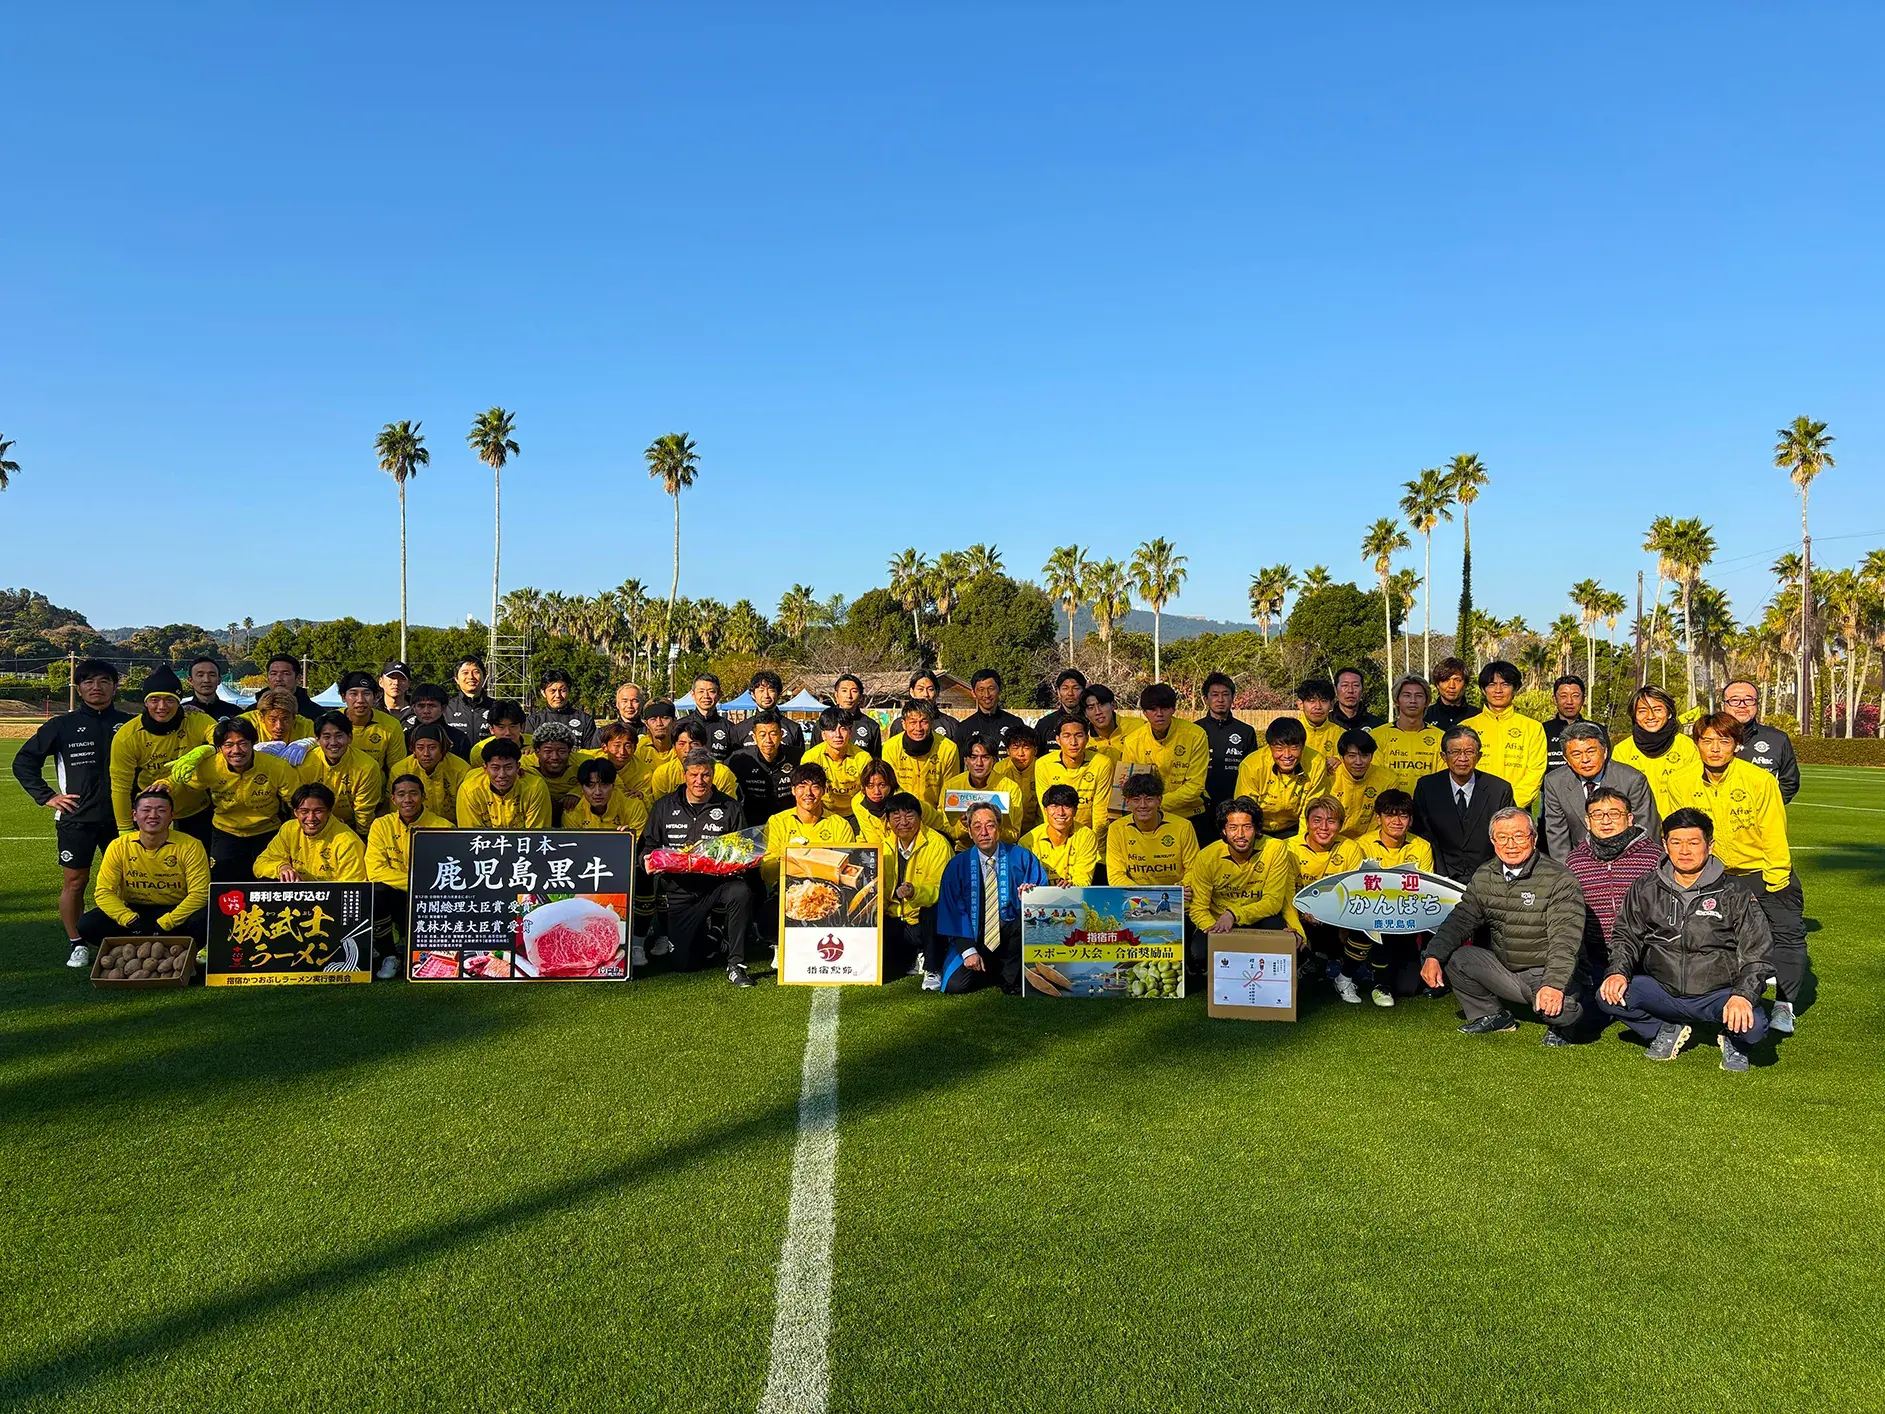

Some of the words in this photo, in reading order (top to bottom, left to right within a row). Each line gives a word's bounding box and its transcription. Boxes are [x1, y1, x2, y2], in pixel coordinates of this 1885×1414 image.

[1226, 748, 1243, 756] Aflac
[1388, 760, 1433, 770] HITACH
[1751, 756, 1773, 765] Aflac
[1729, 806, 1754, 816] Aflac
[702, 823, 724, 832] Aflac
[469, 835, 578, 855] 和牛日本一
[1127, 853, 1146, 861] Aflac
[1128, 863, 1177, 873] HITACHI
[126, 869, 148, 878] Aflac
[430, 856, 615, 892] 鹿児島黒牛
[126, 880, 181, 890] HITACHI
[416, 900, 505, 914] 内閣総理大臣賞
[508, 900, 533, 914] 受賞
[1349, 893, 1442, 915] かんぱち
[227, 904, 335, 945] 勝武士
[413, 919, 504, 934] 農林水産大臣賞
[507, 919, 534, 934] 受賞
[1374, 919, 1417, 929] 鹿児島県
[1086, 932, 1118, 943] 指宿市
[248, 942, 342, 968] ラーメン
[226, 974, 352, 985] 指宿かつおぶしラーメン実行委員会
